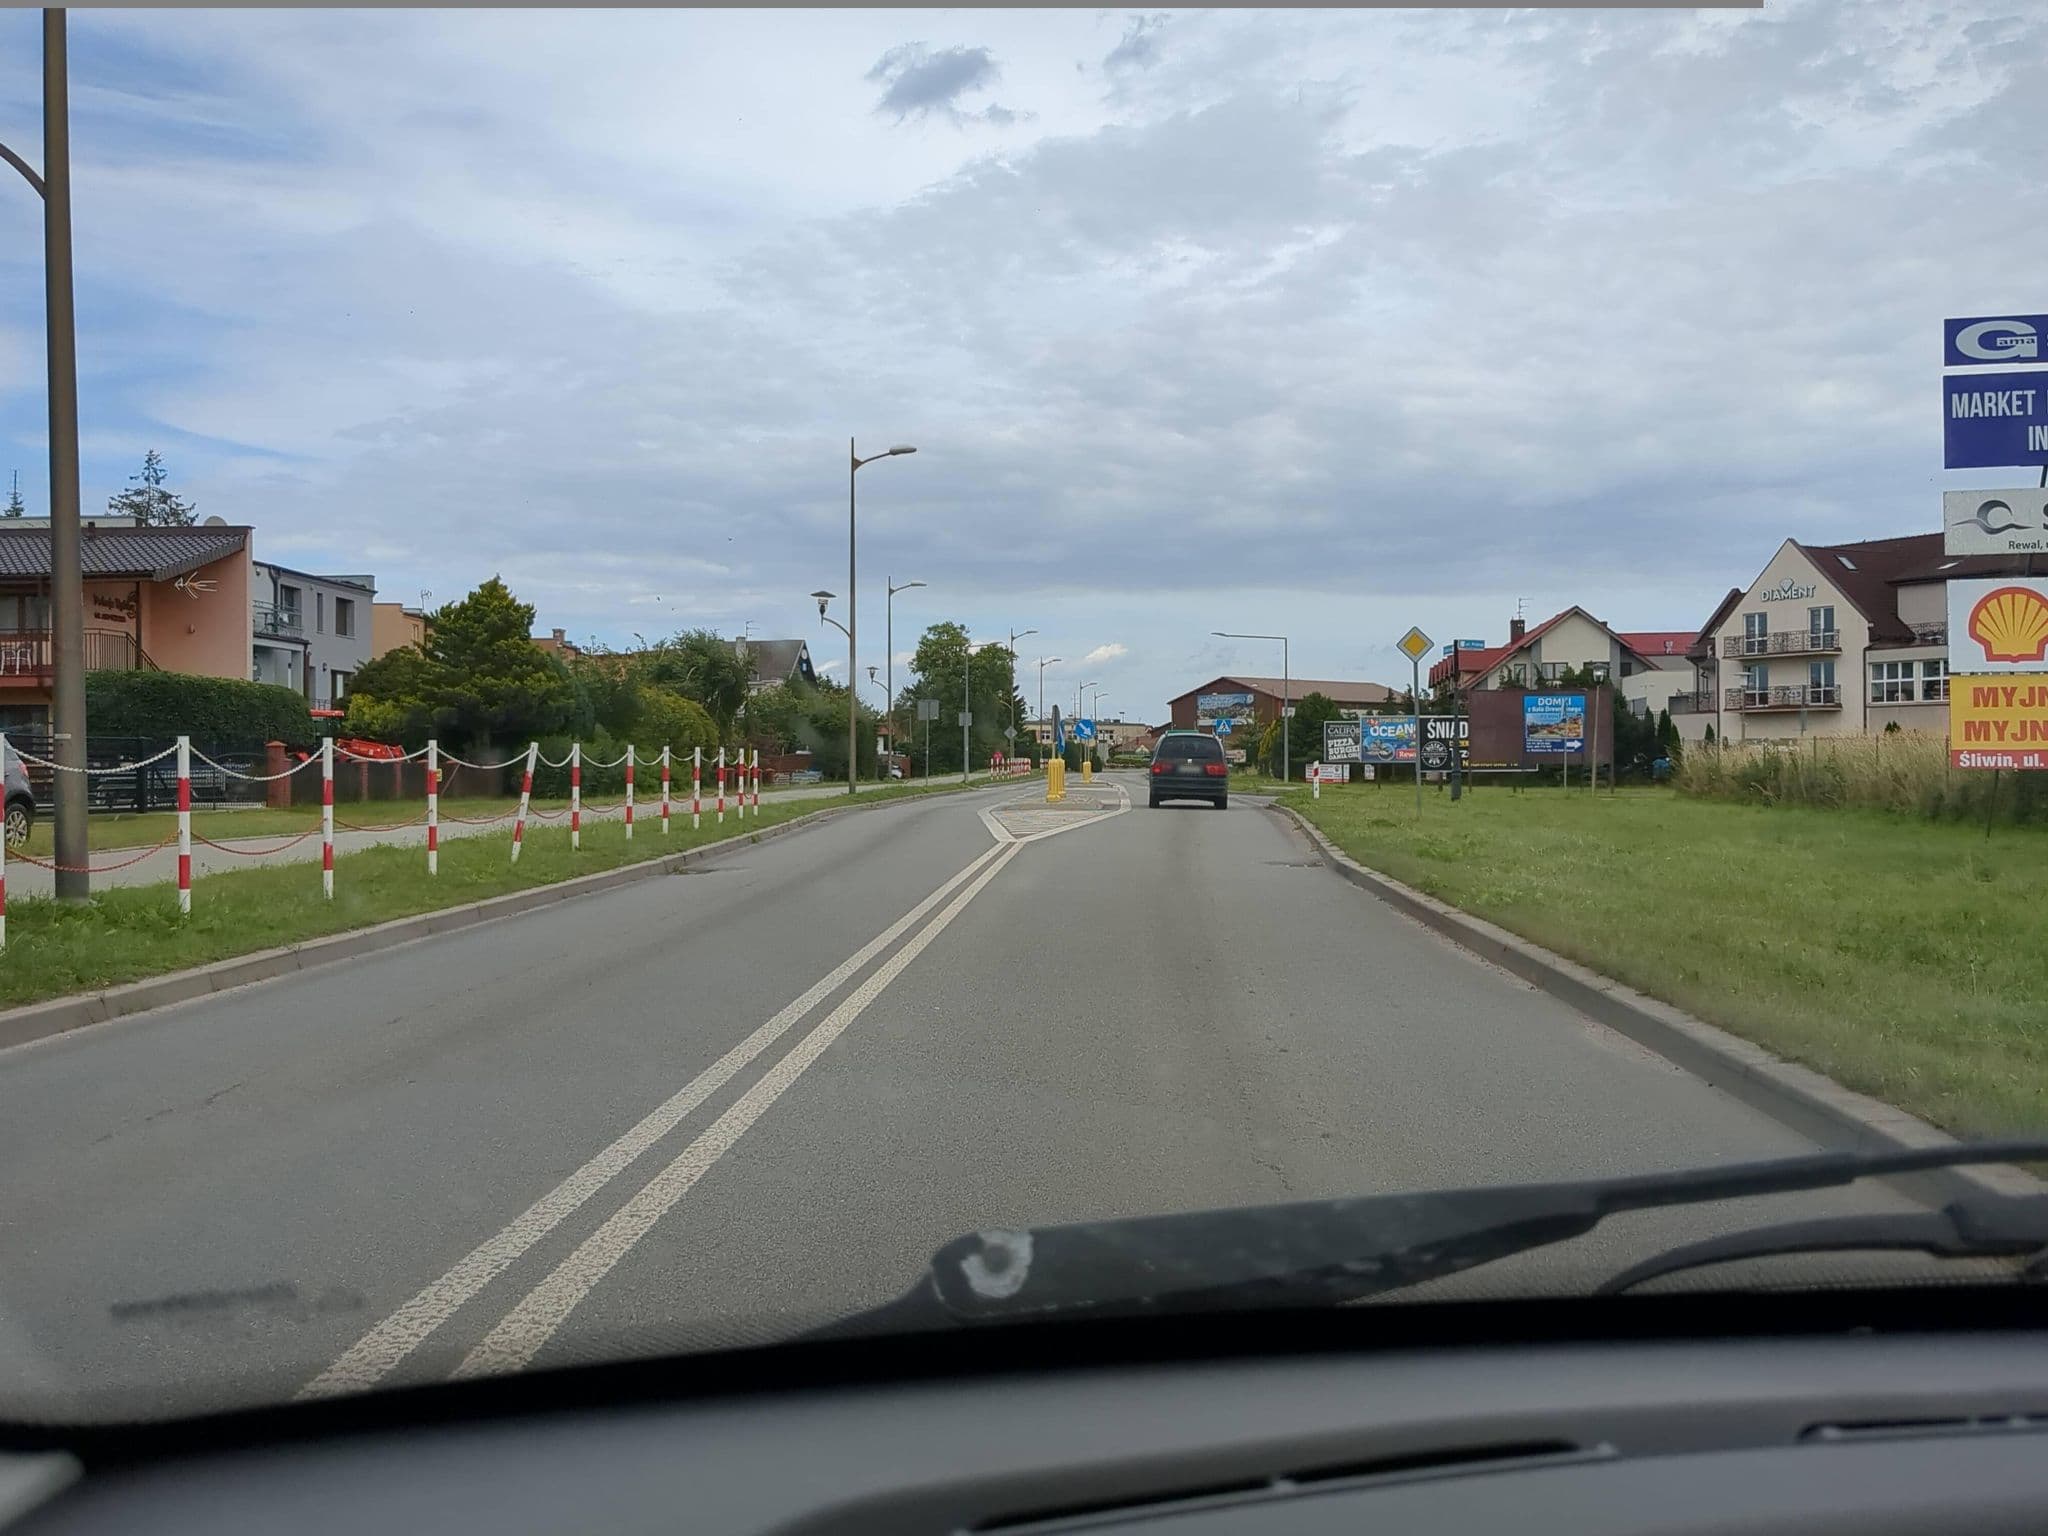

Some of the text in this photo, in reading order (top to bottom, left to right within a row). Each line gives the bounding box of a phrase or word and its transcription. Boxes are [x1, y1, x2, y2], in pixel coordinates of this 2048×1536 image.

[1951, 390, 2036, 419] MARKET
[2008, 540, 2043, 550] Rewal,
[1761, 585, 1816, 602] DIAMENT
[1964, 720, 2048, 742] MYJN
[1959, 751, 2044, 768] Śliwin, ul.
